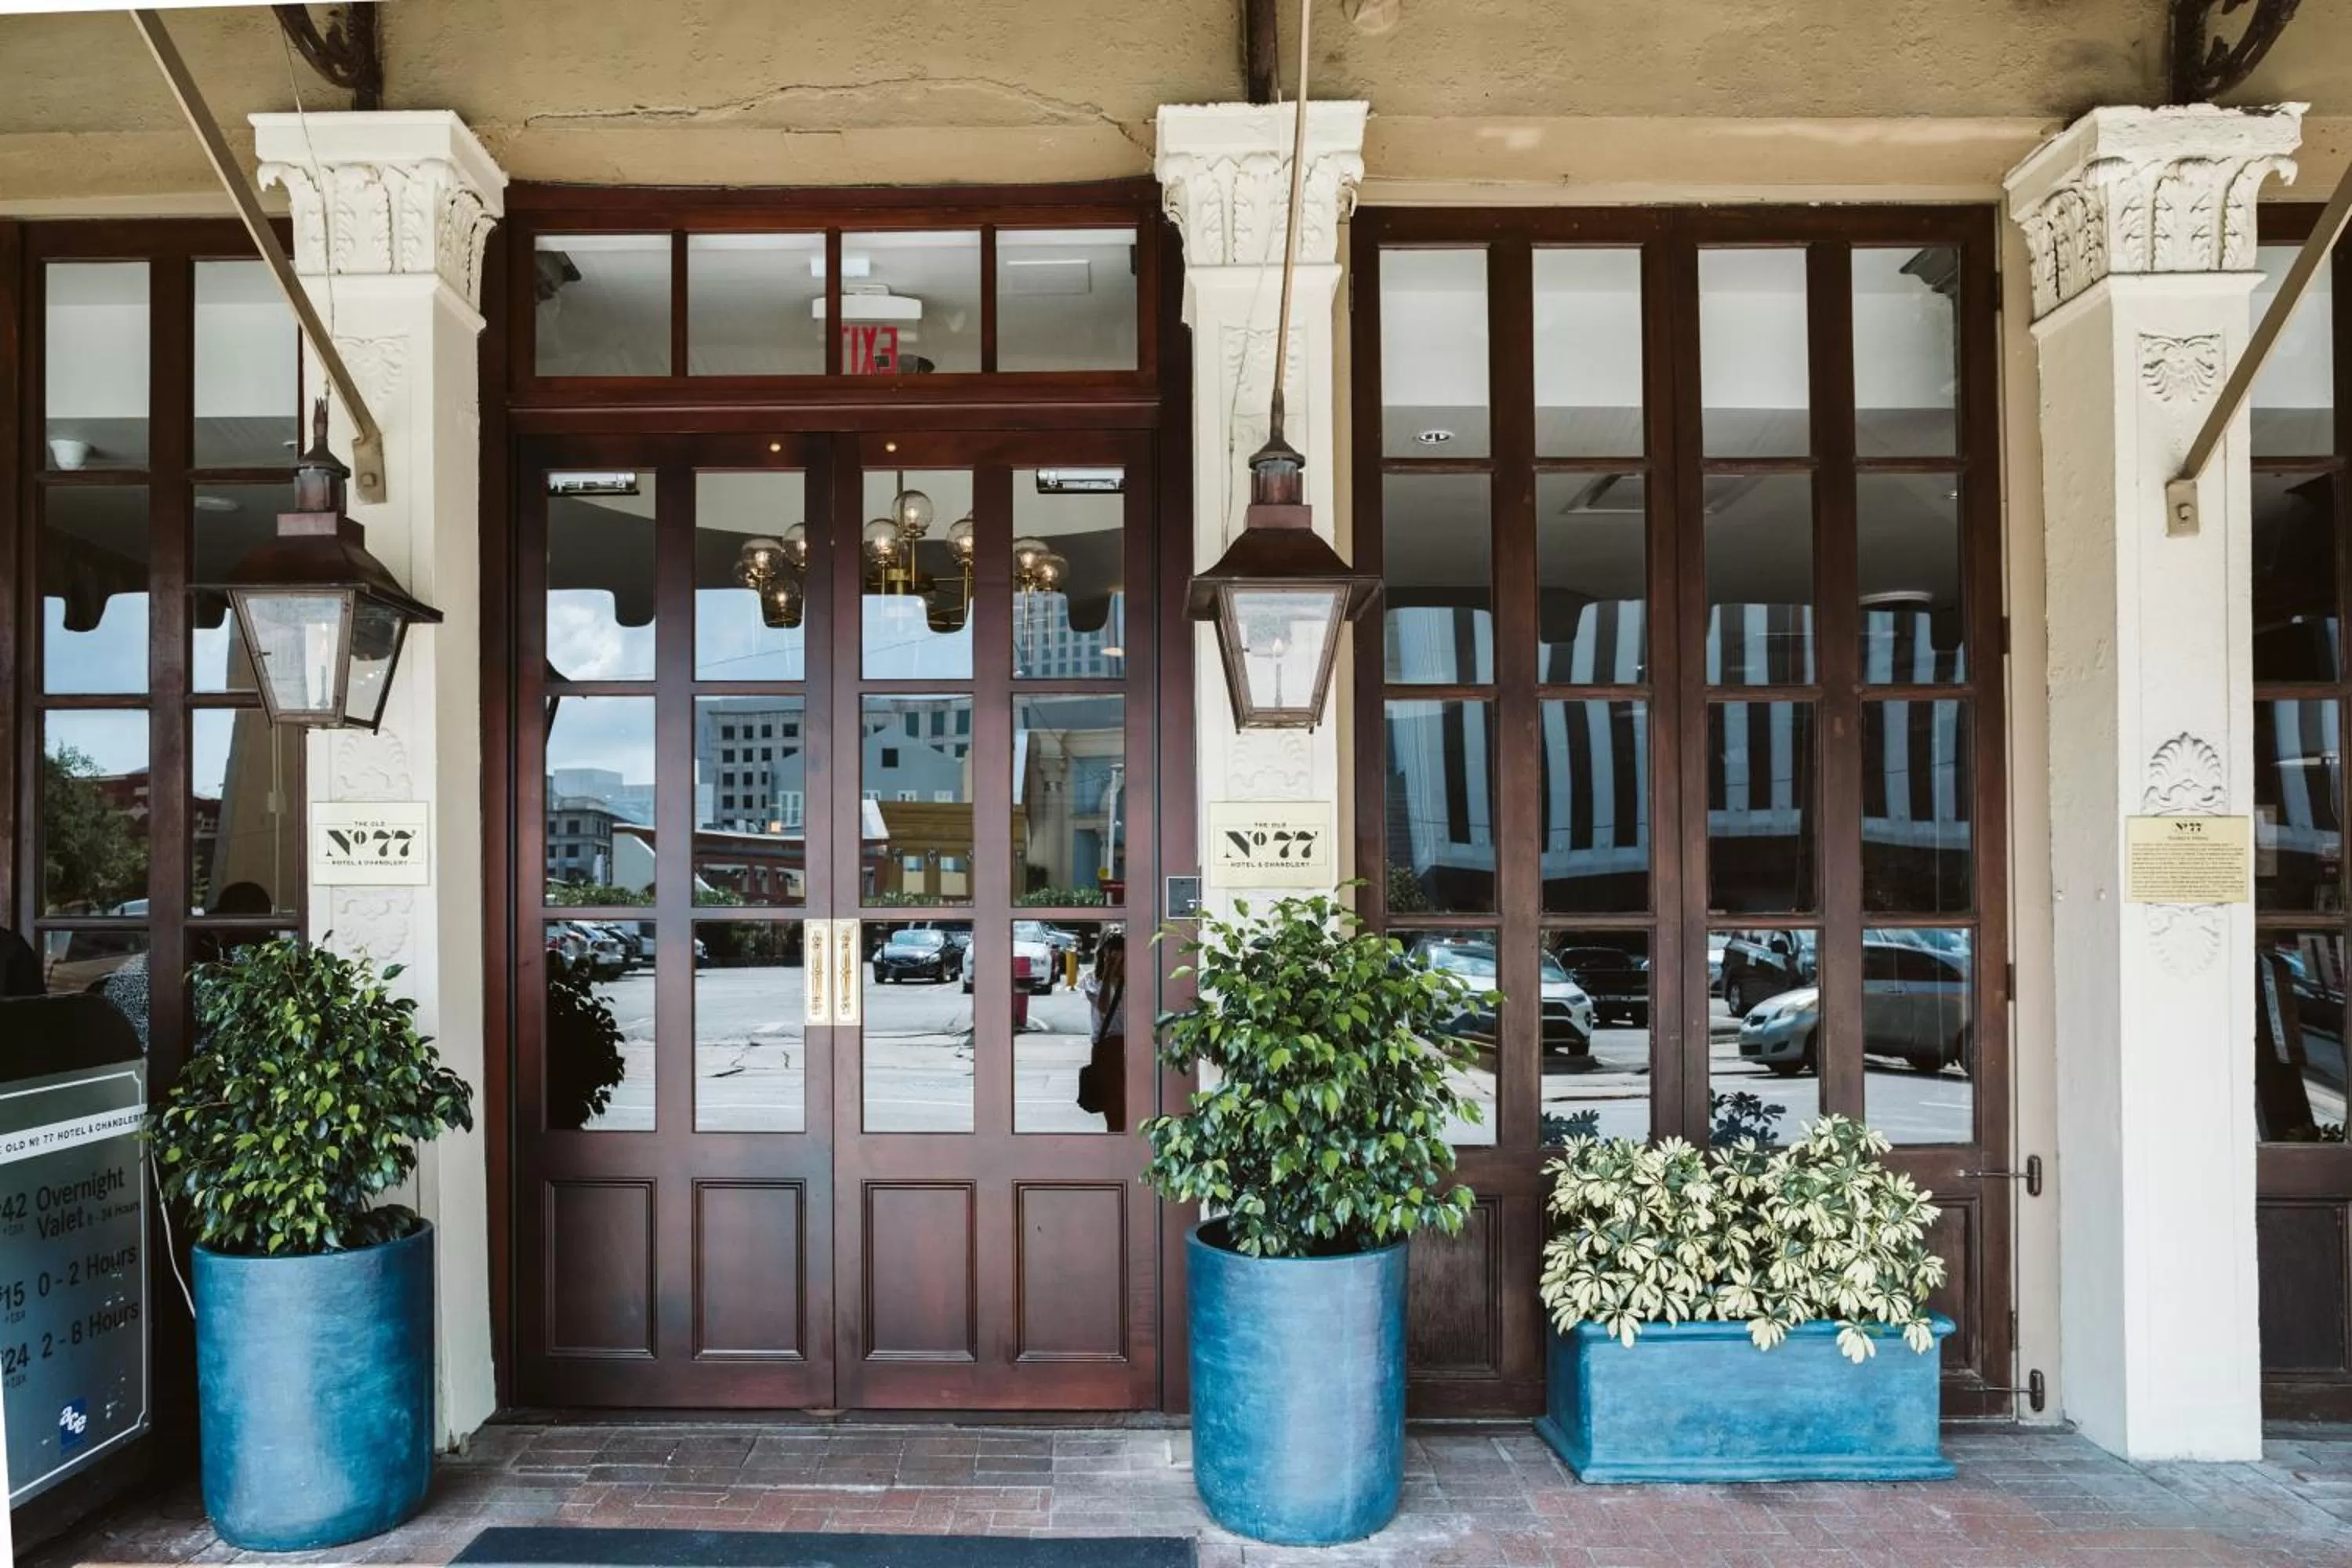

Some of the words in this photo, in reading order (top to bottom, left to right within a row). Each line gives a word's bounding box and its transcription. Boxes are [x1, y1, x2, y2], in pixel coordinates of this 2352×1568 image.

[5, 1141, 25, 1152] OLD
[57, 1127, 85, 1141] HOTEL
[0, 1192, 28, 1222] 42
[36, 1166, 125, 1211] Overnight
[37, 1206, 84, 1240] Valet
[69, 1261, 80, 1286] 2
[87, 1246, 137, 1280] Hours
[42, 1331, 53, 1359] 2
[89, 1302, 139, 1338] Hours
